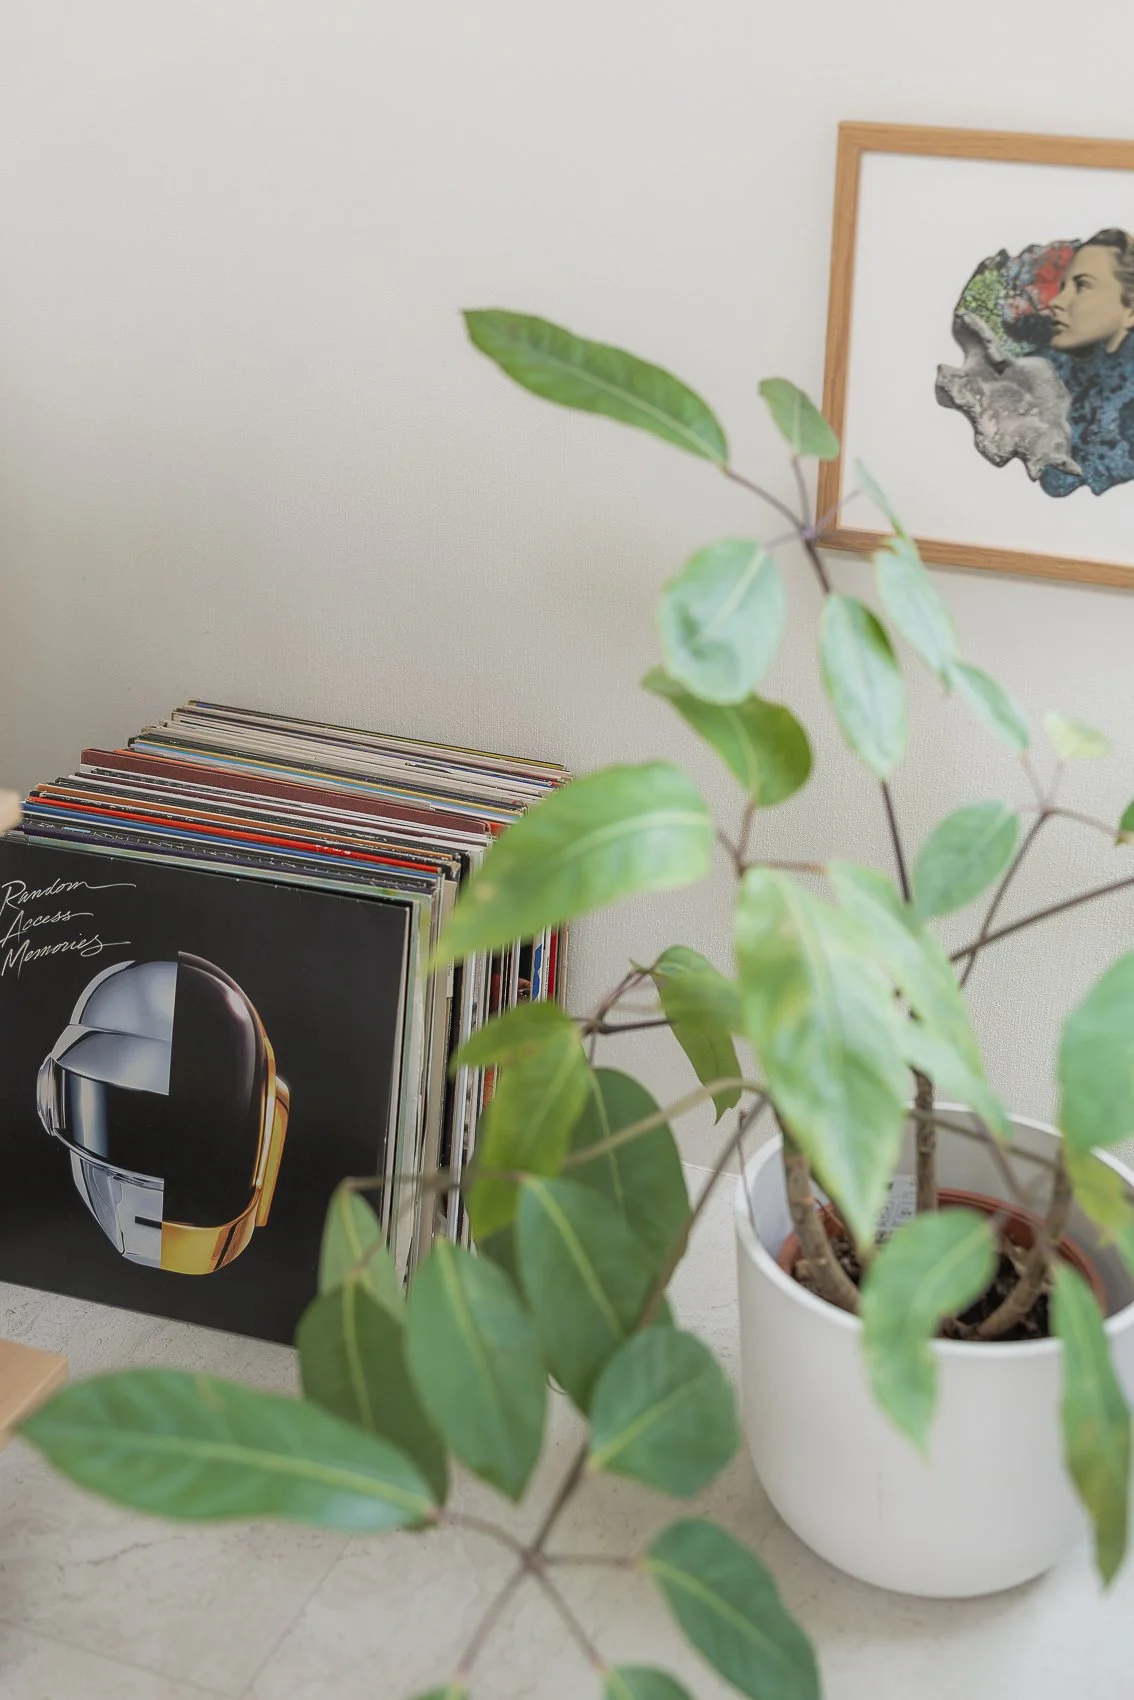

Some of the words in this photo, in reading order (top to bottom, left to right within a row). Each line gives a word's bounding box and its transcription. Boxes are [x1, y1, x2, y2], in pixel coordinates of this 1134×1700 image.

[0, 878, 136, 916] Random
[0, 910, 94, 948] Access
[1, 933, 131, 979] Memories
